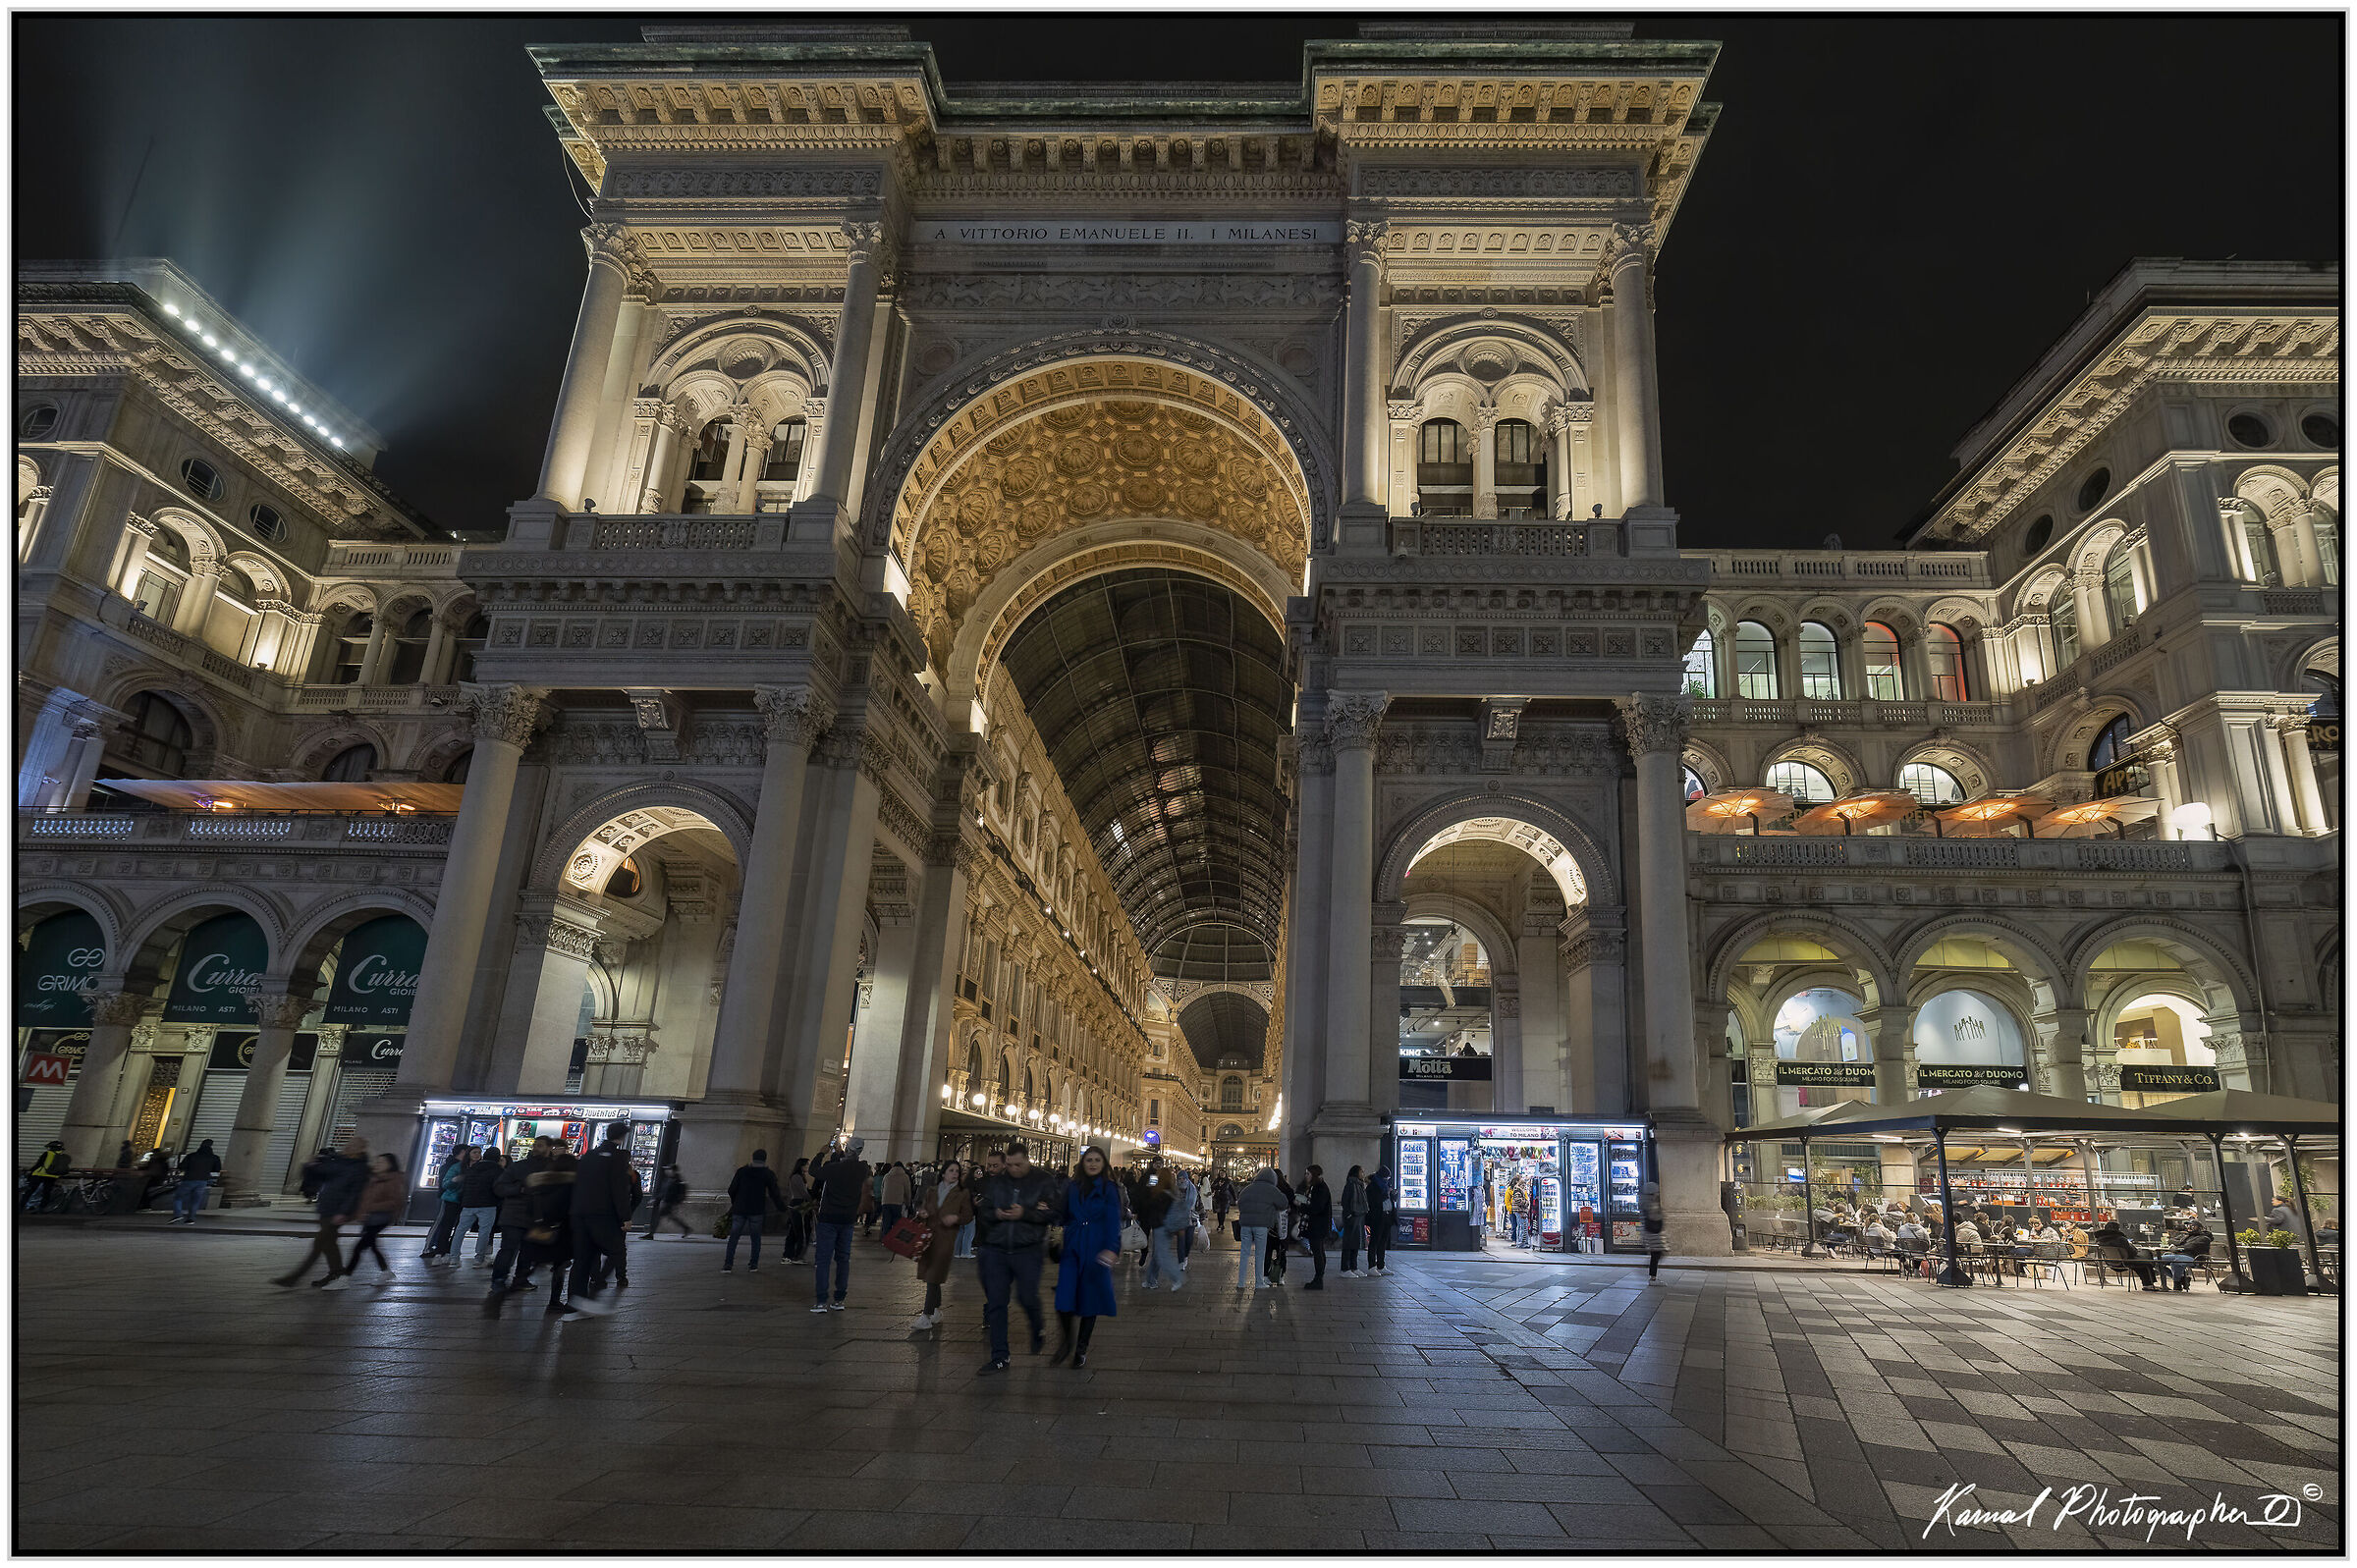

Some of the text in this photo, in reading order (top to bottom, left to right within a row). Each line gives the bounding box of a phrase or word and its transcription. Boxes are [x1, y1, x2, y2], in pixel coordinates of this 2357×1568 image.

[934, 228, 1318, 240] A VITTORIO EMANUELE II. I MILANESI
[1399, 1048, 1421, 1056] KING
[28, 1059, 64, 1079] M
[1407, 1058, 1453, 1074] Motta
[1779, 1066, 1787, 1075] IL
[1788, 1066, 1833, 1076] MERCATO
[1929, 1069, 1973, 1078] MERCATO
[1986, 1070, 2024, 1079] DUOMO
[2183, 1074, 2194, 1085] &
